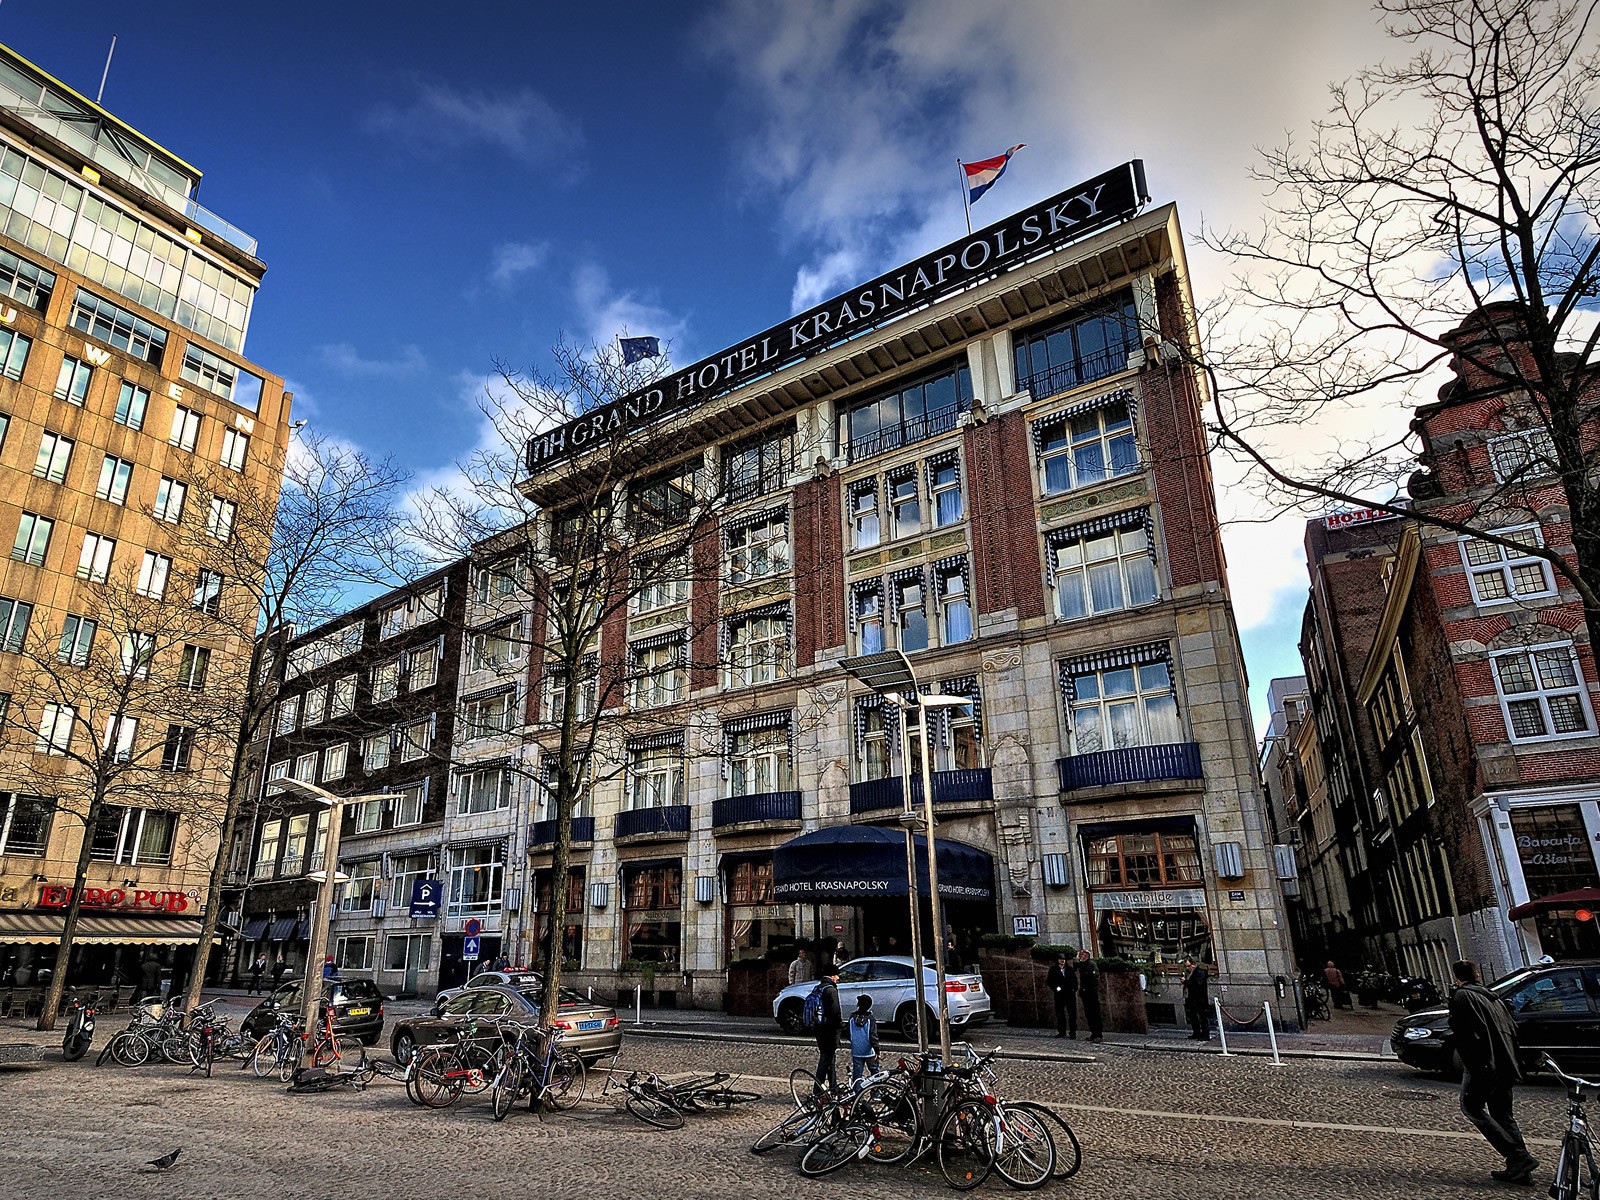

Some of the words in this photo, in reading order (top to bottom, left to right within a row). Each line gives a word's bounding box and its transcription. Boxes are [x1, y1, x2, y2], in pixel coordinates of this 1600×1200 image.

[571, 389, 664, 446] GRAND
[676, 337, 780, 401] HOTEL
[789, 183, 1106, 350] KRASNAPOLSKY
[789, 882, 813, 892] HOTEL
[815, 881, 889, 891] KRASNAPOLSKY
[132, 889, 188, 912] PUB
[421, 889, 431, 900] P
[1122, 891, 1173, 903] Mathilde
